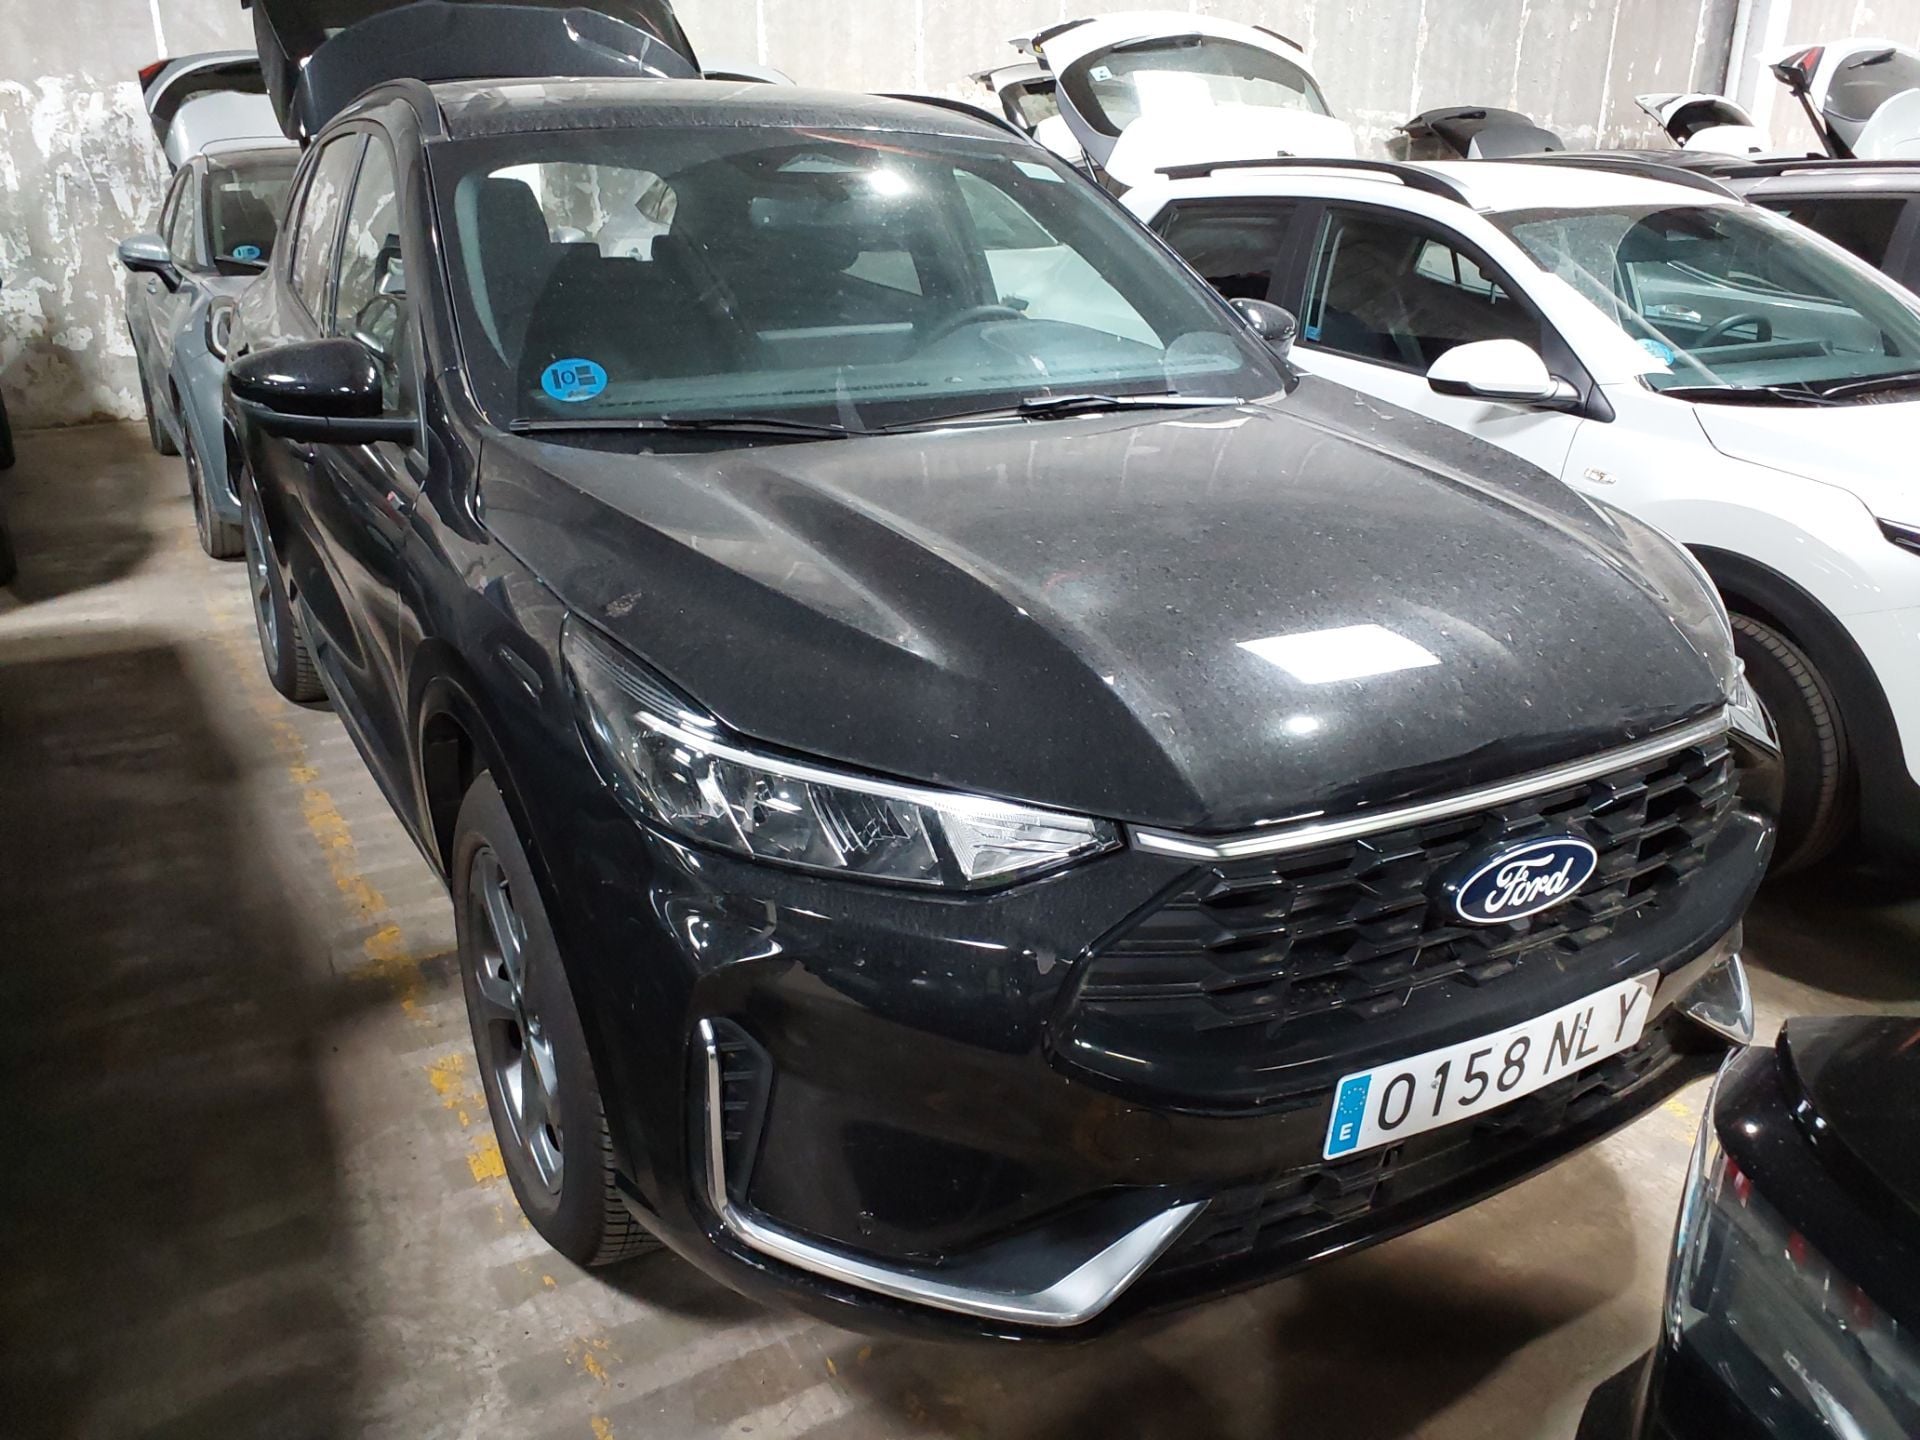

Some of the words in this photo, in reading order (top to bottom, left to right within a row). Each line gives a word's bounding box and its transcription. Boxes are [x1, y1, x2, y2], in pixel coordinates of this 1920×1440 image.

[1484, 853, 1575, 914] Ford
[1378, 1036, 1531, 1131] 0158
[1339, 1122, 1354, 1141] E
